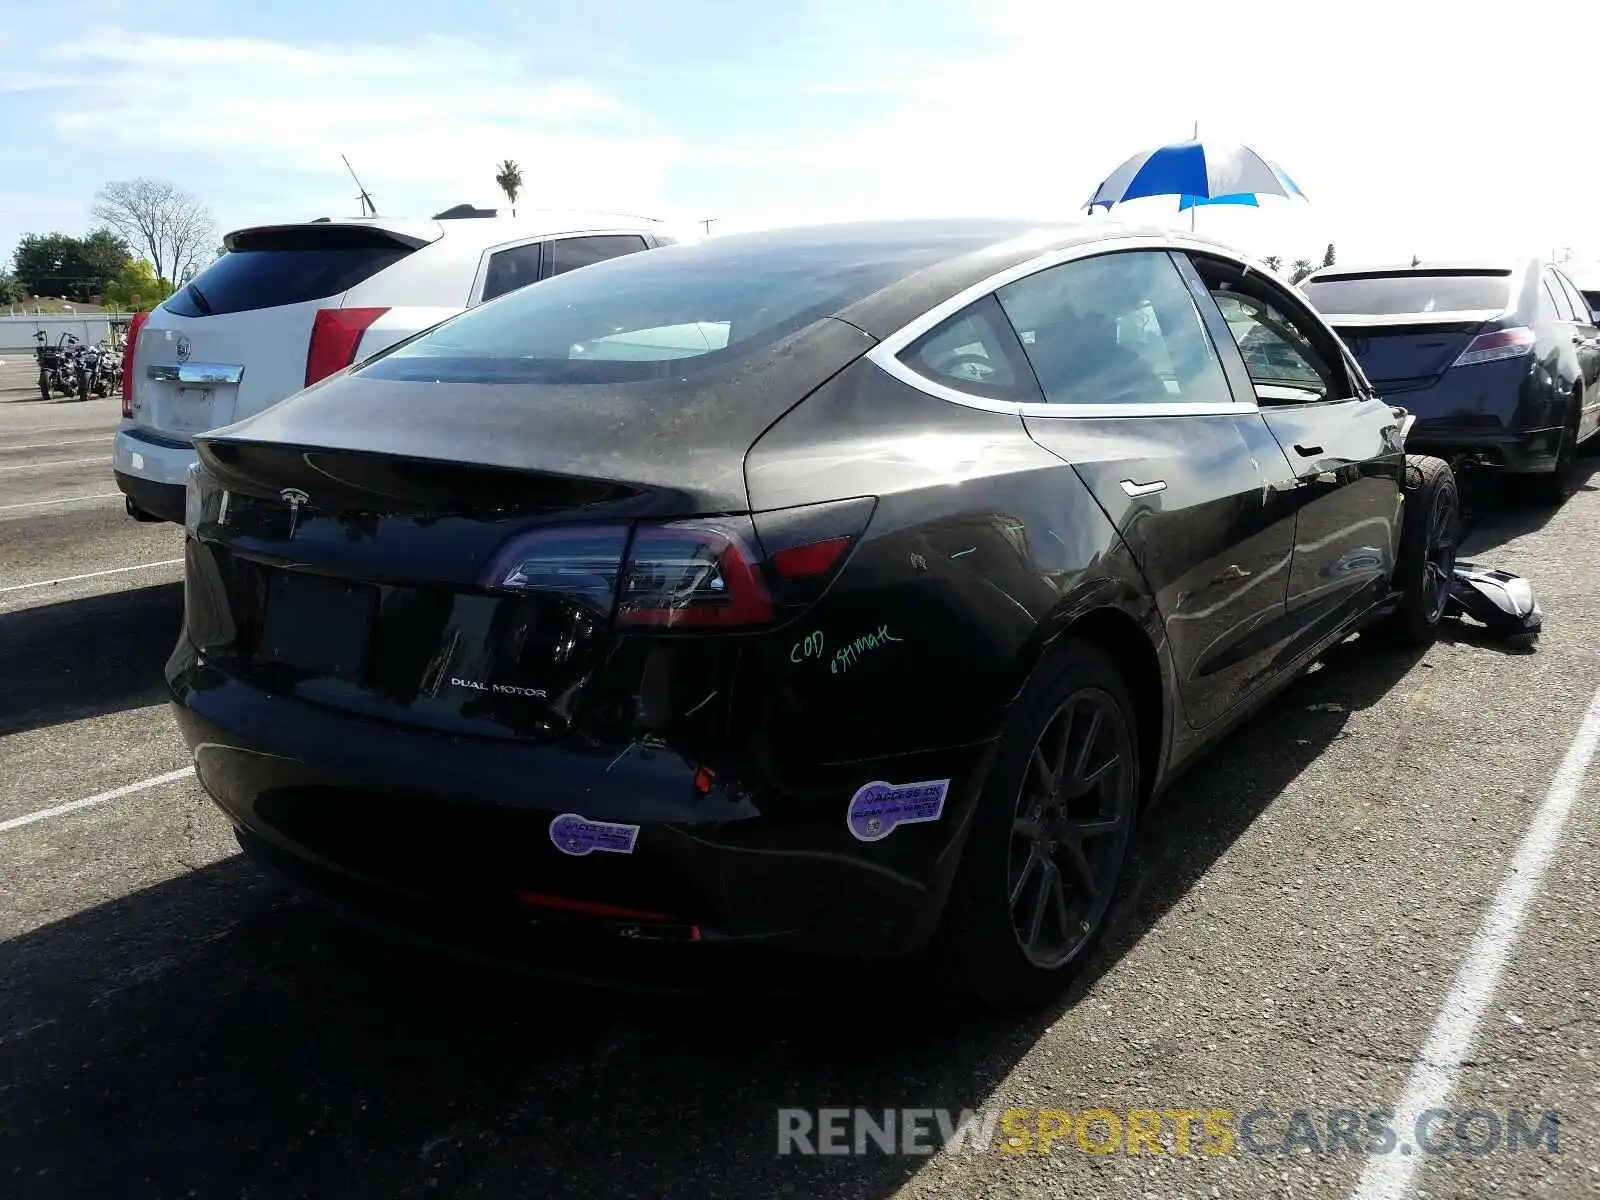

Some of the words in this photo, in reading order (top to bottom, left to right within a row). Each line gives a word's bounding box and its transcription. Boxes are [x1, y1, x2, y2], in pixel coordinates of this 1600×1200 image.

[790, 630, 824, 663] COD
[451, 677, 489, 691] DUAL
[493, 684, 548, 698] MOTOR
[873, 789, 921, 802] ACCESS
